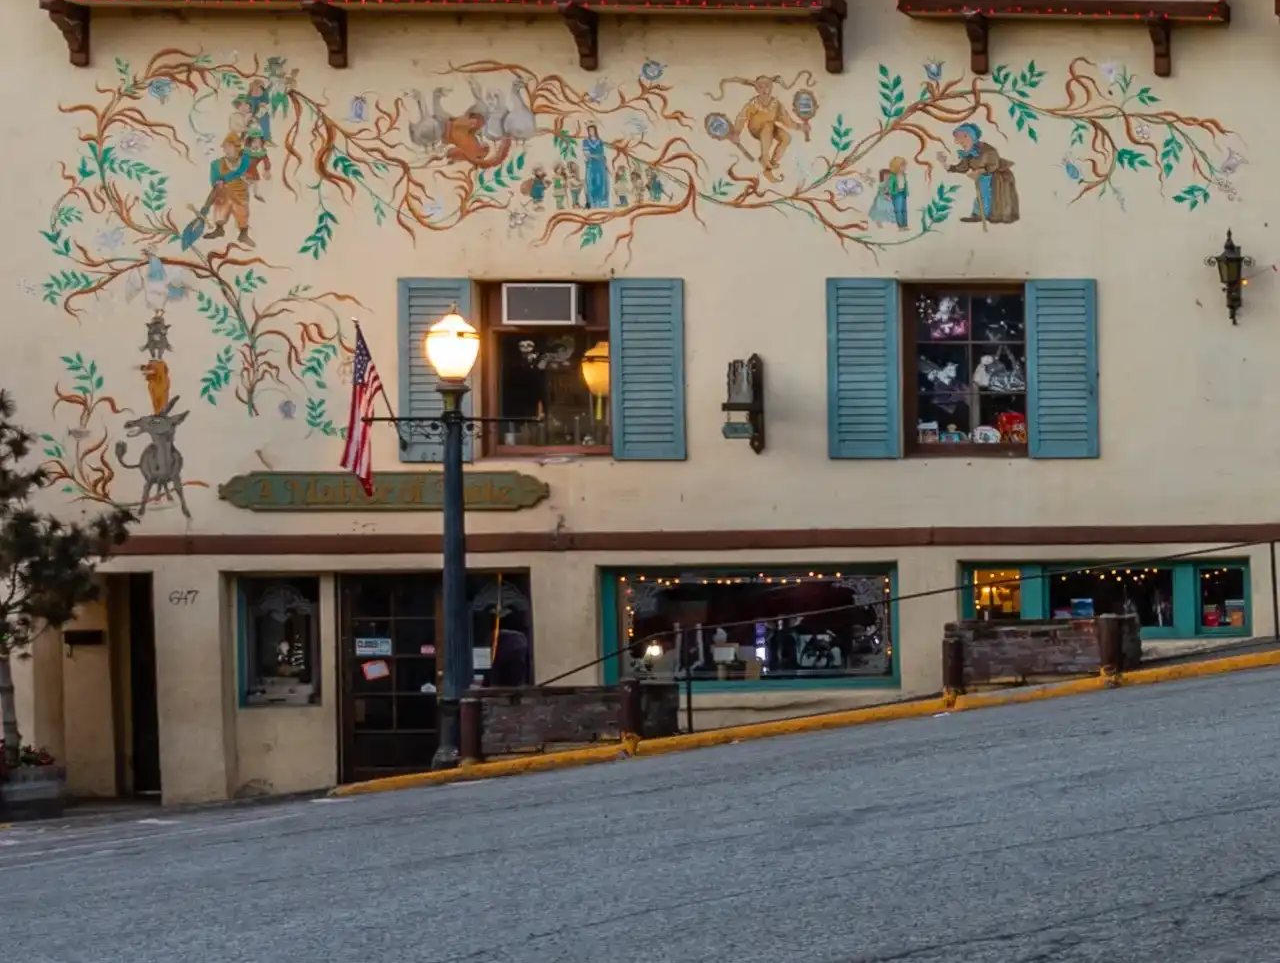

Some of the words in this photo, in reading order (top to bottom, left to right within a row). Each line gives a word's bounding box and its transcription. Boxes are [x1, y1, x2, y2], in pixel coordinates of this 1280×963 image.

[255, 478, 276, 502] A
[399, 476, 424, 503] of
[168, 590, 200, 606] 647
